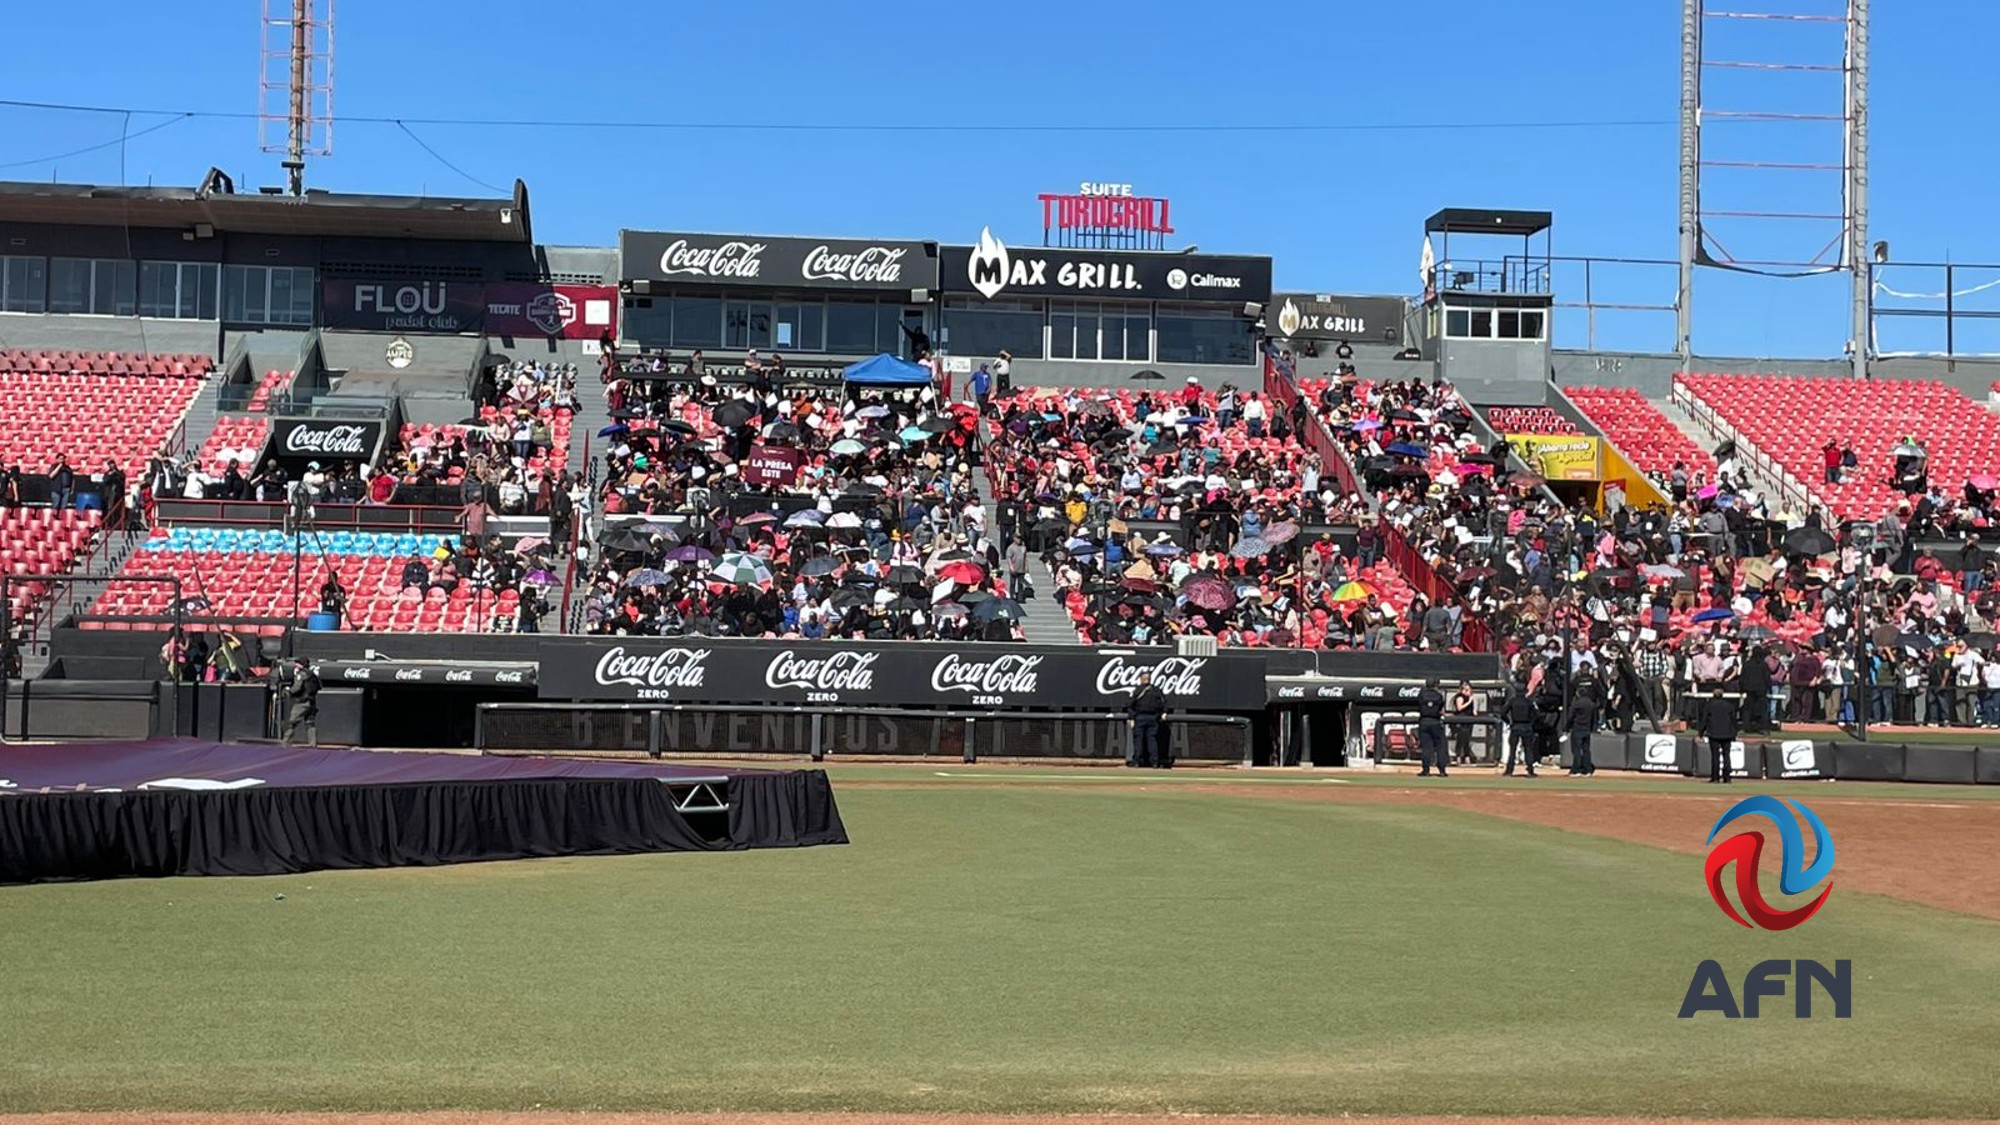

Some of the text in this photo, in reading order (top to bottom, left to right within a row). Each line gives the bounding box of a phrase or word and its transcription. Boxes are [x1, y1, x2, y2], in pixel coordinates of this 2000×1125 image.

[1080, 183, 1132, 196] SUITE
[1037, 194, 1174, 233] TOROGRILL
[660, 240, 767, 277] Coca-Cola
[802, 245, 907, 282] Coca-Cola
[1190, 273, 1241, 288] Calimax
[487, 304, 521, 315] TECATE
[1324, 316, 1366, 333] GRILL
[286, 424, 367, 453] Coca-Cola
[751, 458, 793, 471] LA PRESA
[761, 469, 781, 478] ESTE
[595, 646, 711, 687] Coca-Cola
[765, 650, 880, 690] Coca-Cola
[931, 653, 1044, 693] Coca-Cola
[637, 689, 669, 699] ZERO
[807, 692, 838, 701] ZERO
[972, 695, 1003, 705] ZERO
